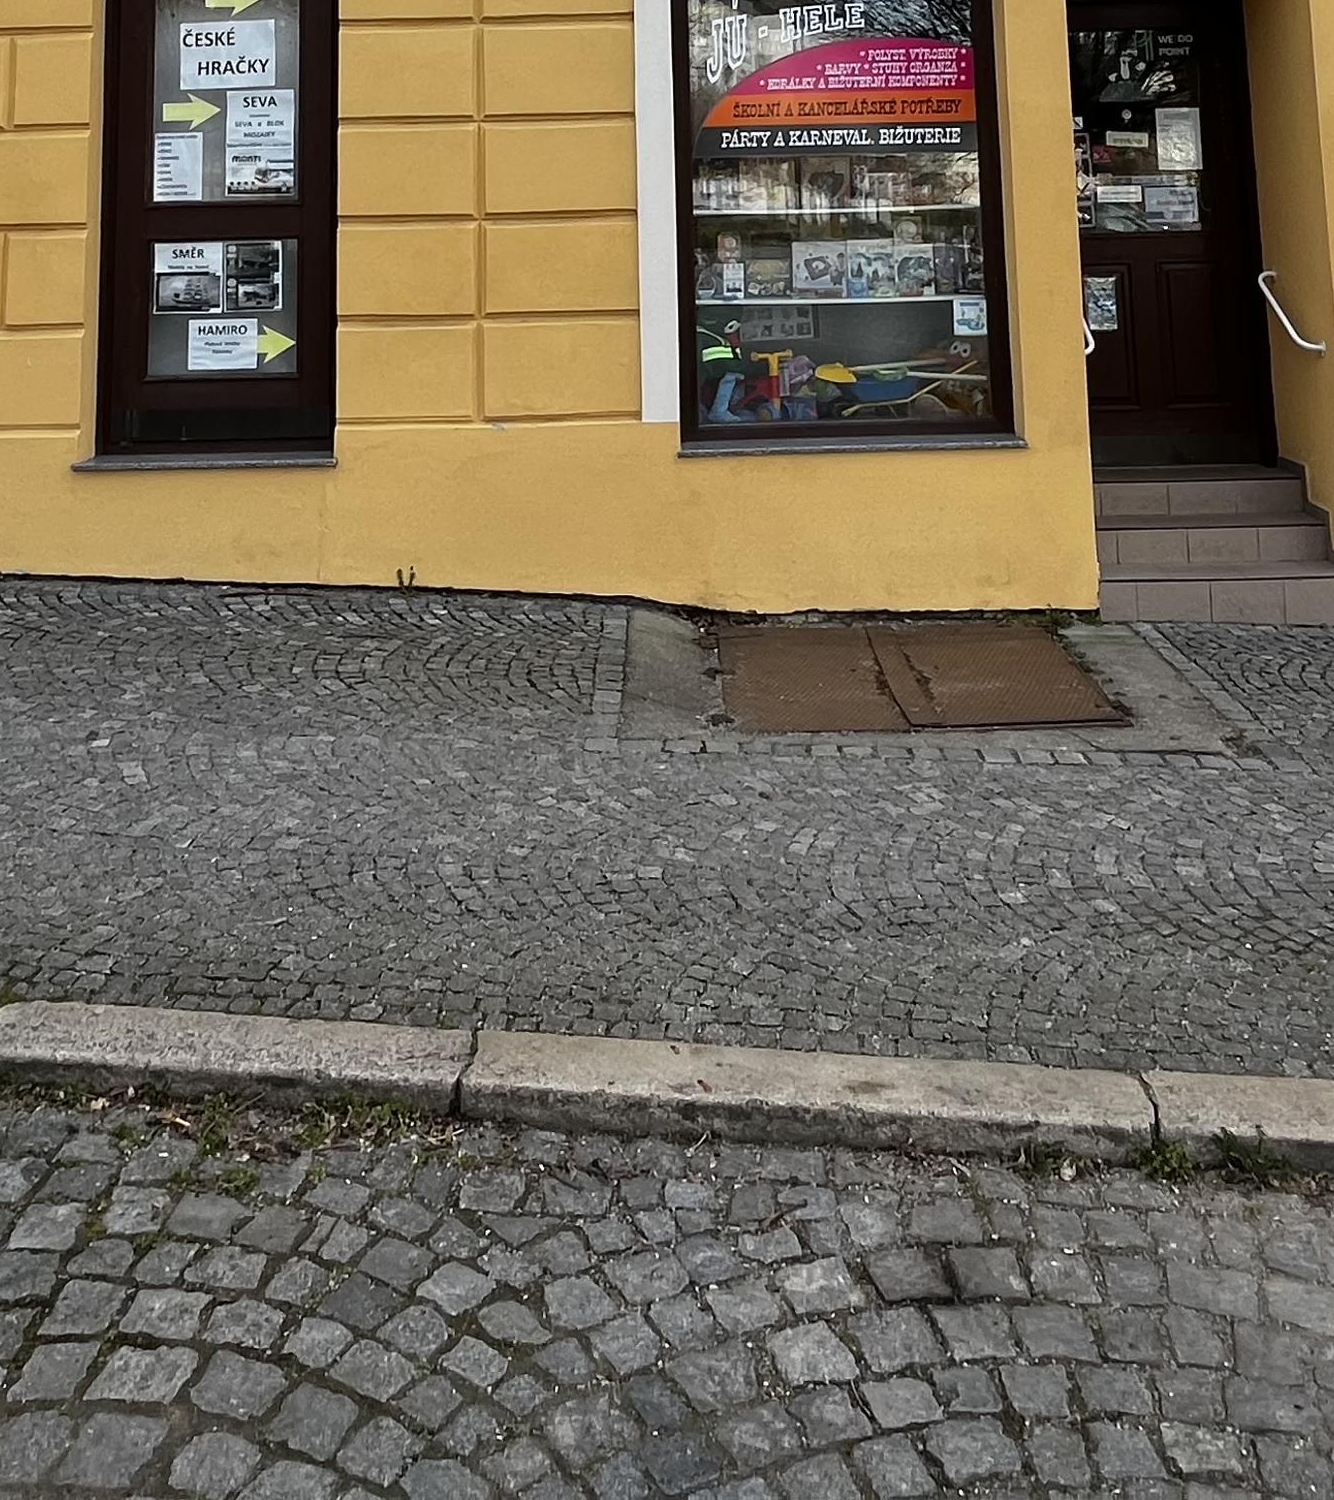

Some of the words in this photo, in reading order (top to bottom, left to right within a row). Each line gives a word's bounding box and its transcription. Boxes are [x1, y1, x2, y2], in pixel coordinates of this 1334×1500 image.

[779, 3, 865, 43] HELE
[182, 27, 236, 48] ČESKÉ
[197, 55, 270, 76] HRAČKY
[818, 79, 825, 88] A
[243, 96, 277, 108] SEVA
[733, 102, 781, 118] ŠKOLNÍ
[784, 103, 794, 116] A
[797, 97, 897, 116] KANCELÁŘSKÉ
[900, 97, 962, 114] POTŘEBY
[721, 129, 772, 149] PÁRTY
[773, 131, 785, 147] A
[878, 125, 962, 145] BIŽUTERIE
[172, 247, 205, 259] SMĚR
[198, 324, 248, 336] HAMIRO
